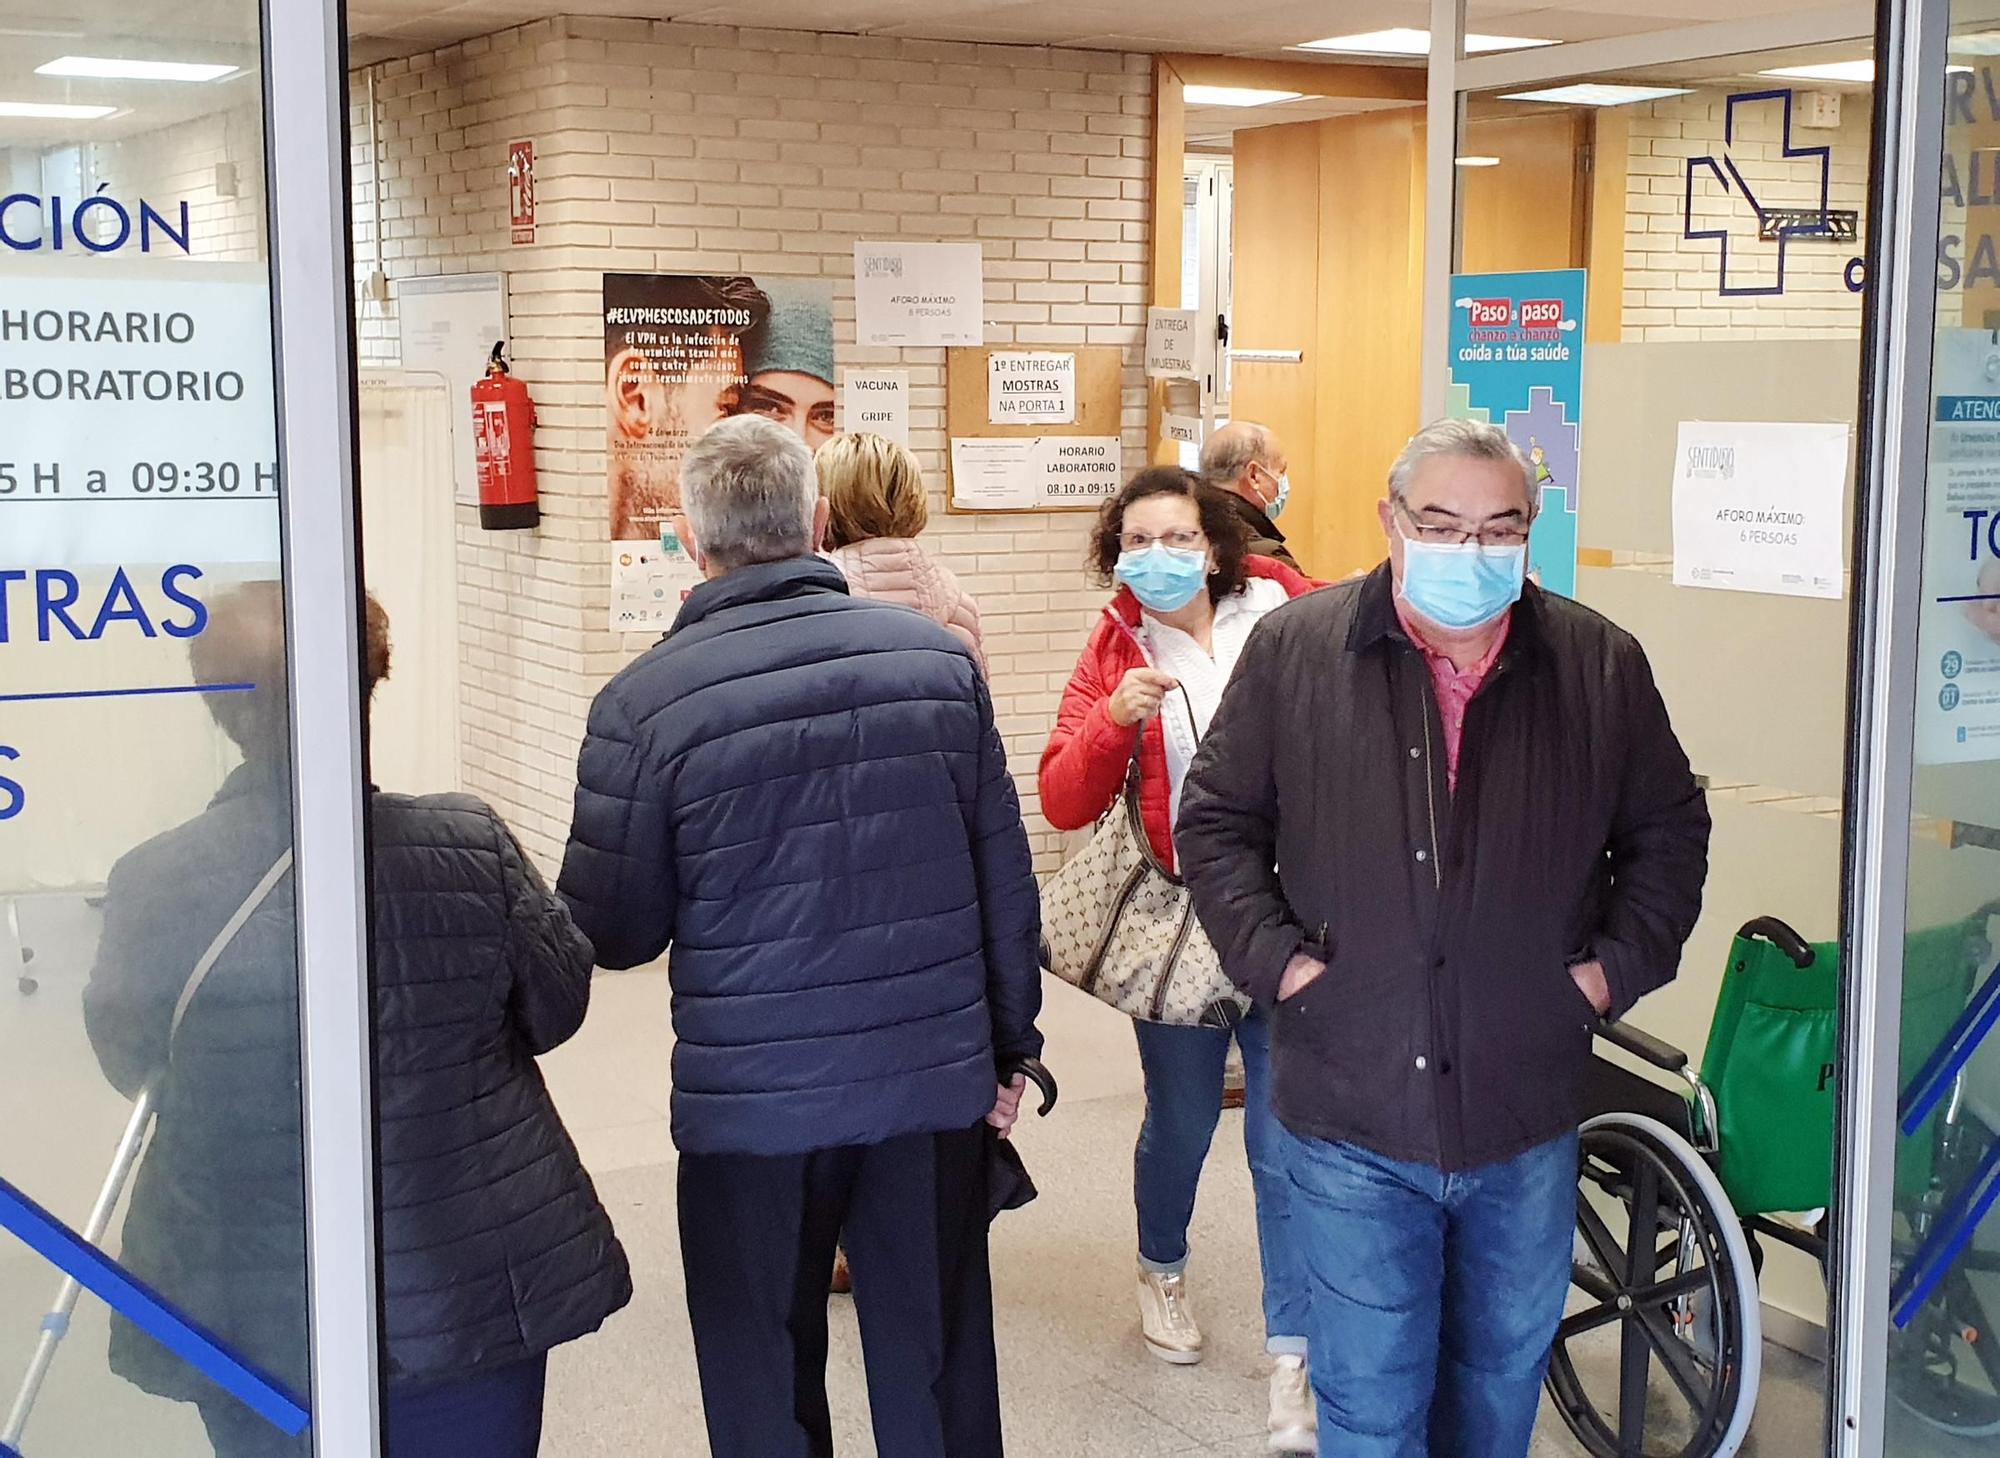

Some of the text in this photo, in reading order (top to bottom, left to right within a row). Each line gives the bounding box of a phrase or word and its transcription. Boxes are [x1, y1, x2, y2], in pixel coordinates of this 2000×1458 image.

[1942, 152, 2000, 207] AL
[0, 183, 190, 255] CIÓN
[890, 296, 919, 305] AFORO
[606, 308, 750, 325] #ELVPHESCOSADETODOS
[1472, 302, 1560, 327] Paso a paso
[2, 310, 195, 344] HORARIO
[1155, 319, 1188, 331] ENTREGA
[637, 332, 656, 344] VPH
[729, 333, 740, 345] de
[1469, 328, 1507, 341] chanzo
[1520, 328, 1560, 341] chanzo
[1164, 339, 1174, 350] DE
[1459, 343, 1569, 360] coida a túa saúde
[1010, 360, 1069, 371] ENTREGAR
[1151, 358, 1191, 370] MUESTRAS
[0, 369, 244, 400] BORATORIO
[855, 381, 898, 390] VACUNA
[1003, 380, 1059, 391] MOSTRAS
[1000, 400, 1064, 411] NA PORTA 1
[861, 412, 893, 421] GRIPE
[1059, 447, 1105, 456] HORARIO
[1047, 463, 1116, 473] LABORATORIO
[34, 463, 60, 493] H
[87, 469, 107, 492] a
[132, 462, 241, 493] 09:30
[255, 462, 277, 492] H
[1087, 483, 1115, 493] 09:15
[1716, 510, 1753, 523] AFORO
[1741, 530, 1798, 545] 6 PERSOAS
